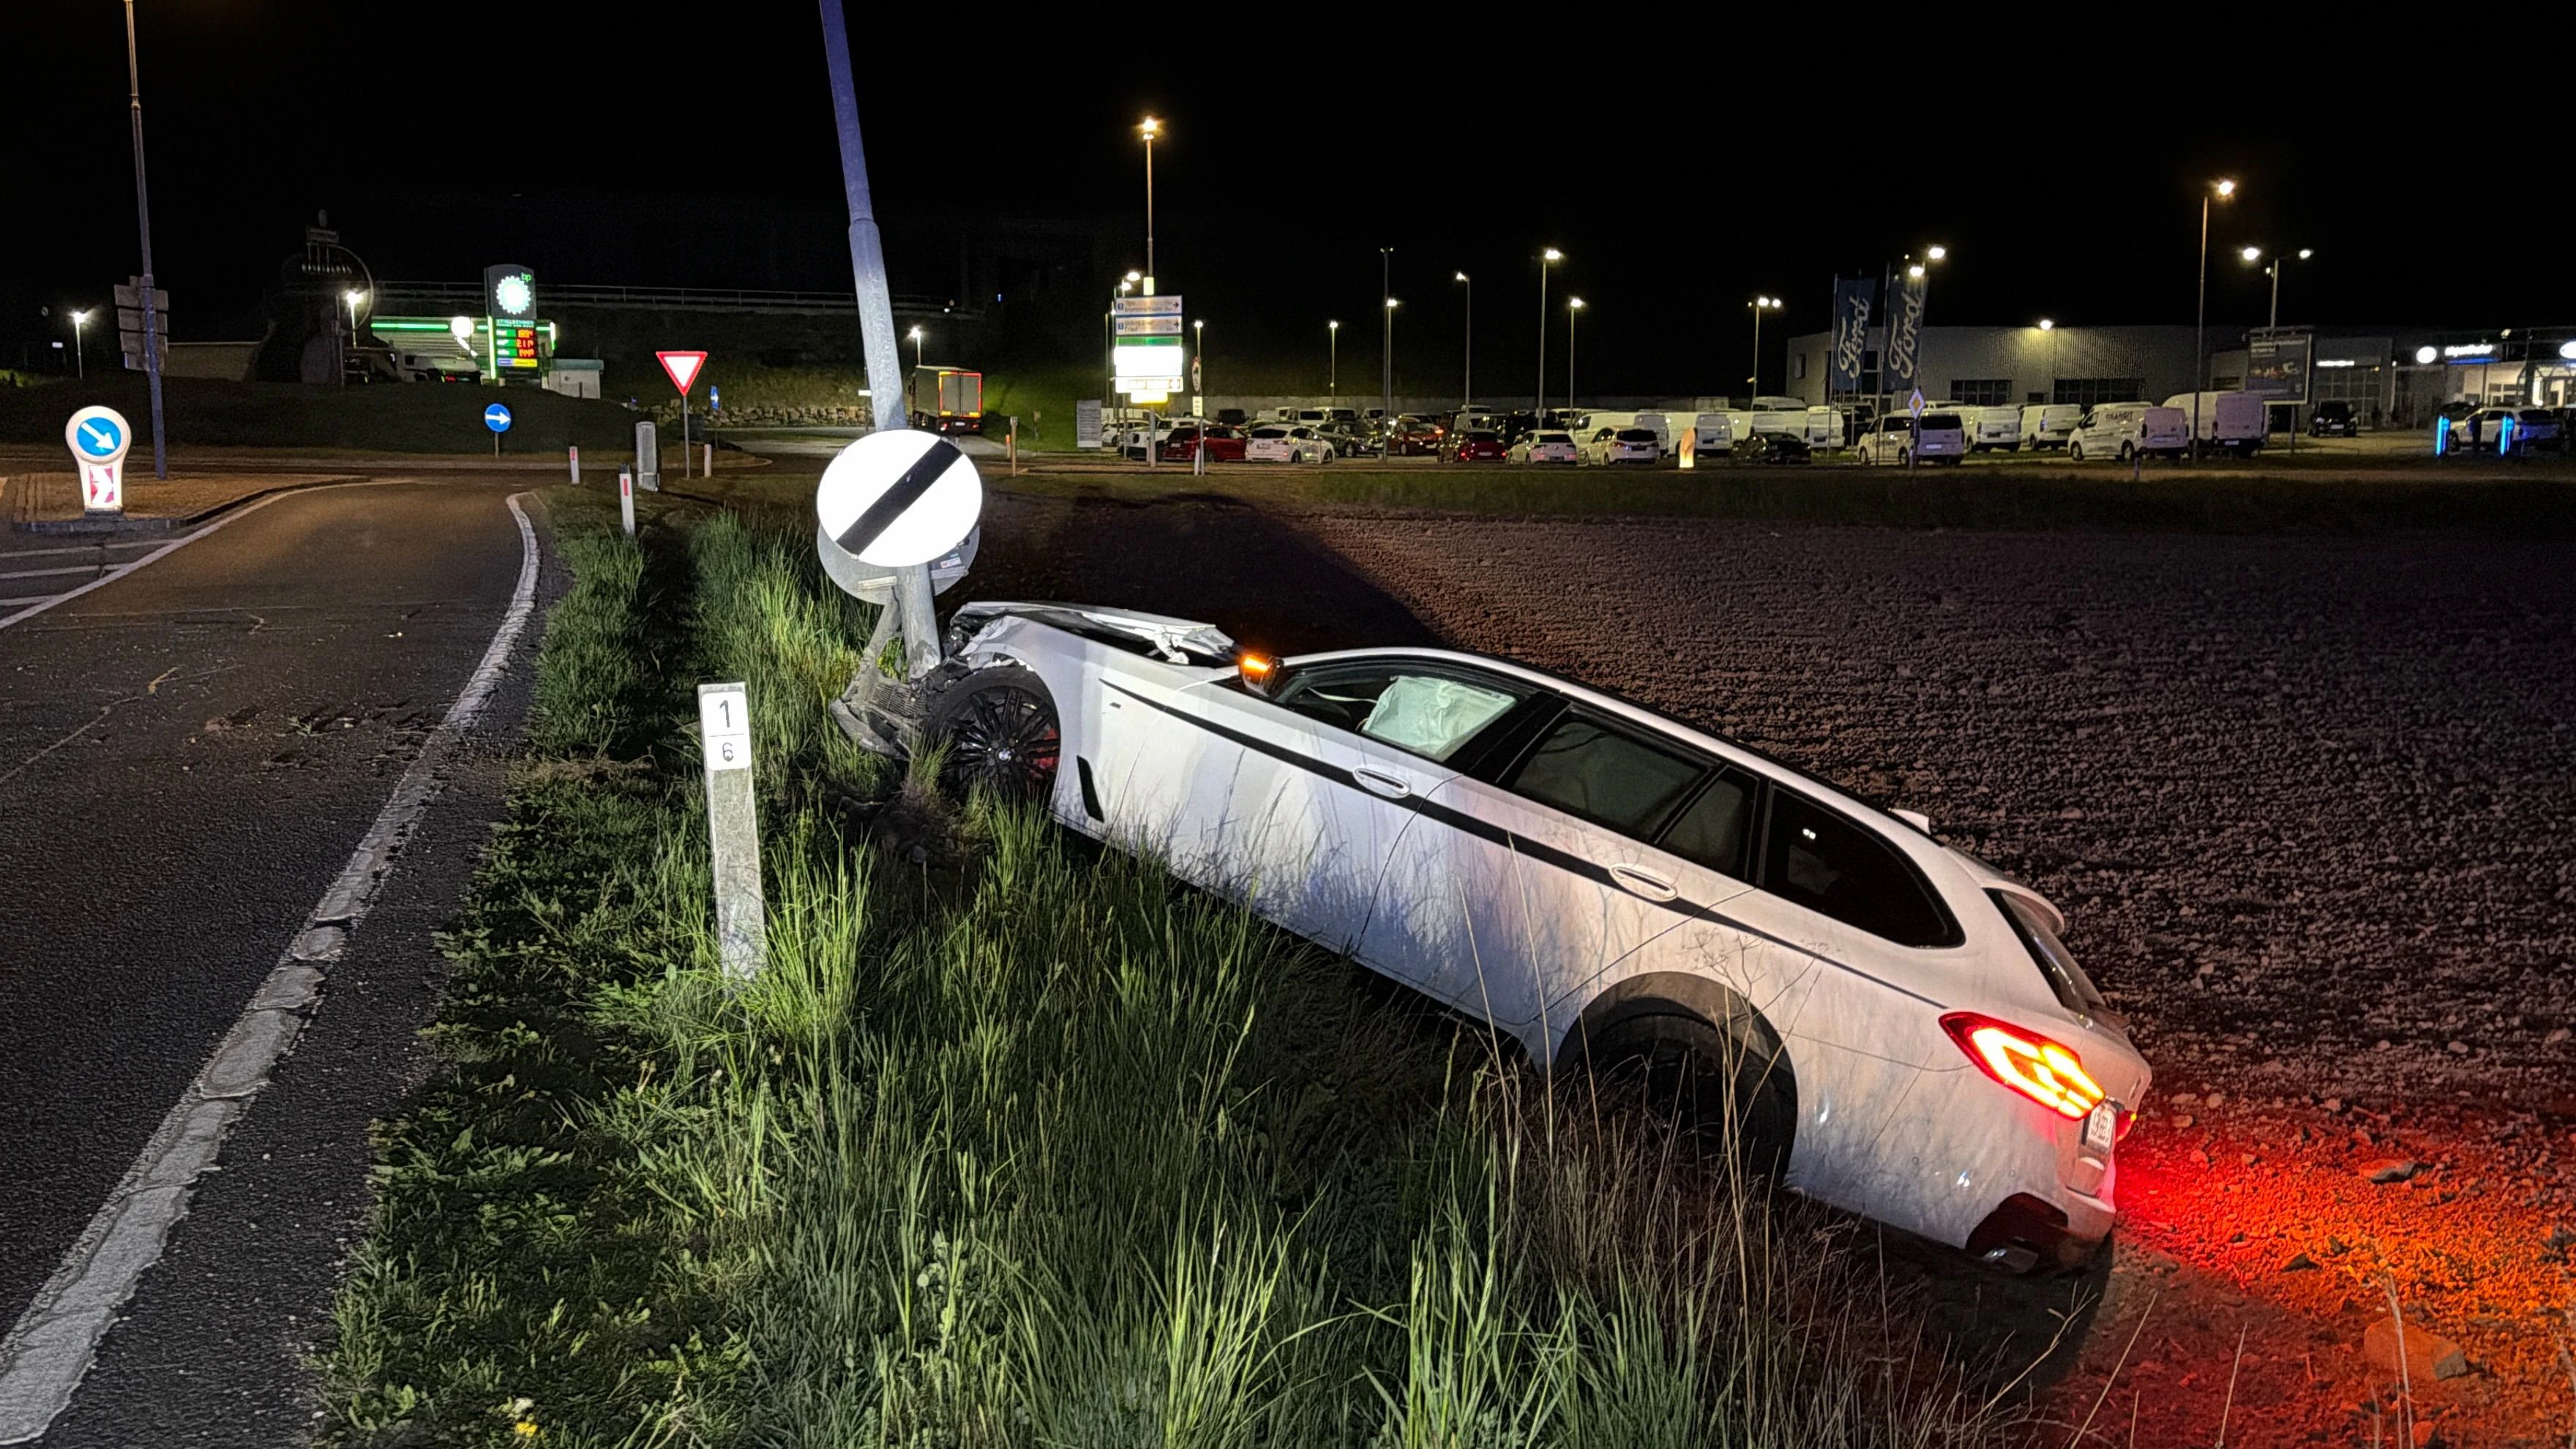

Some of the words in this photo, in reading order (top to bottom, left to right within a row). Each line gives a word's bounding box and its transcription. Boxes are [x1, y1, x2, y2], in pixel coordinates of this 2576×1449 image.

[521, 272, 531, 282] bp
[1838, 295, 1870, 378] Ford
[1889, 292, 1921, 378] Ford
[719, 700, 730, 728] 1
[722, 742, 734, 763] 6
